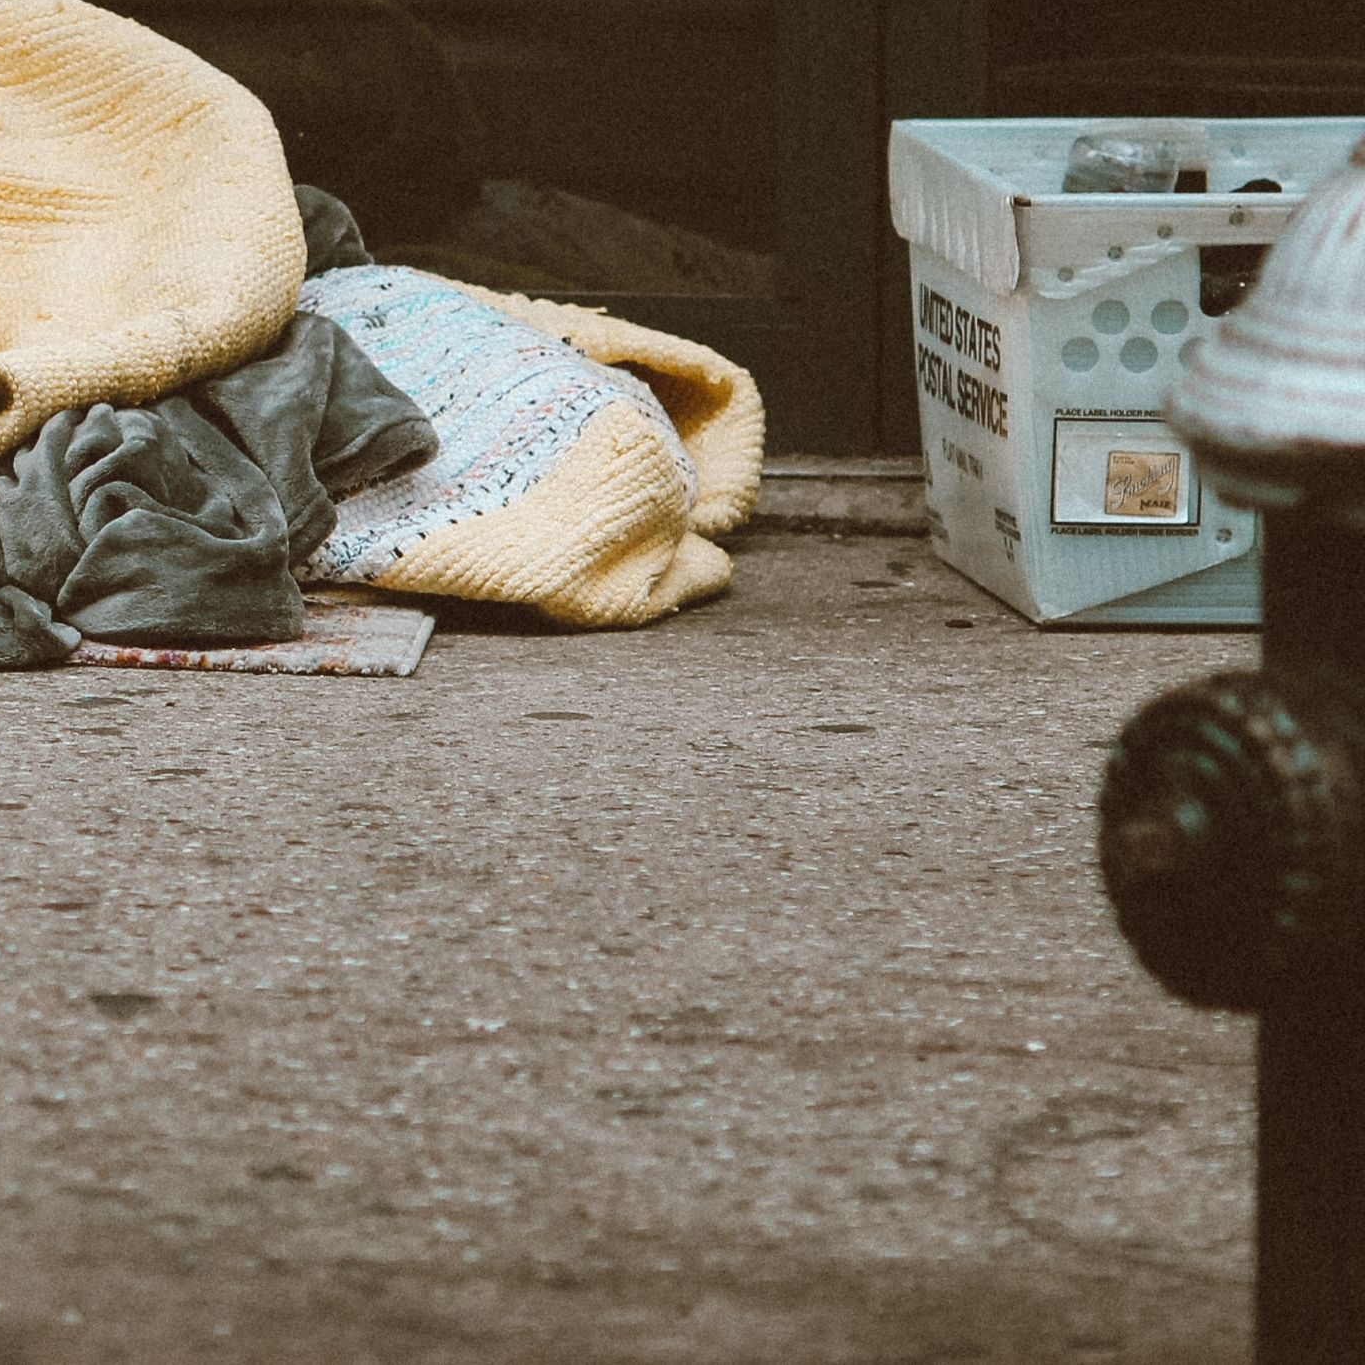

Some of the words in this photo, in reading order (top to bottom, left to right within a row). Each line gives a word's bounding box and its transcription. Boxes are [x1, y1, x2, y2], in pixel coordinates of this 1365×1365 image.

[920, 283, 954, 346] UNITED
[955, 306, 1001, 372] STATES
[918, 342, 956, 410] POSTAL
[956, 369, 1008, 438] SERVICE
[1055, 408, 1081, 417] PLACE
[1083, 409, 1108, 417] LABEL
